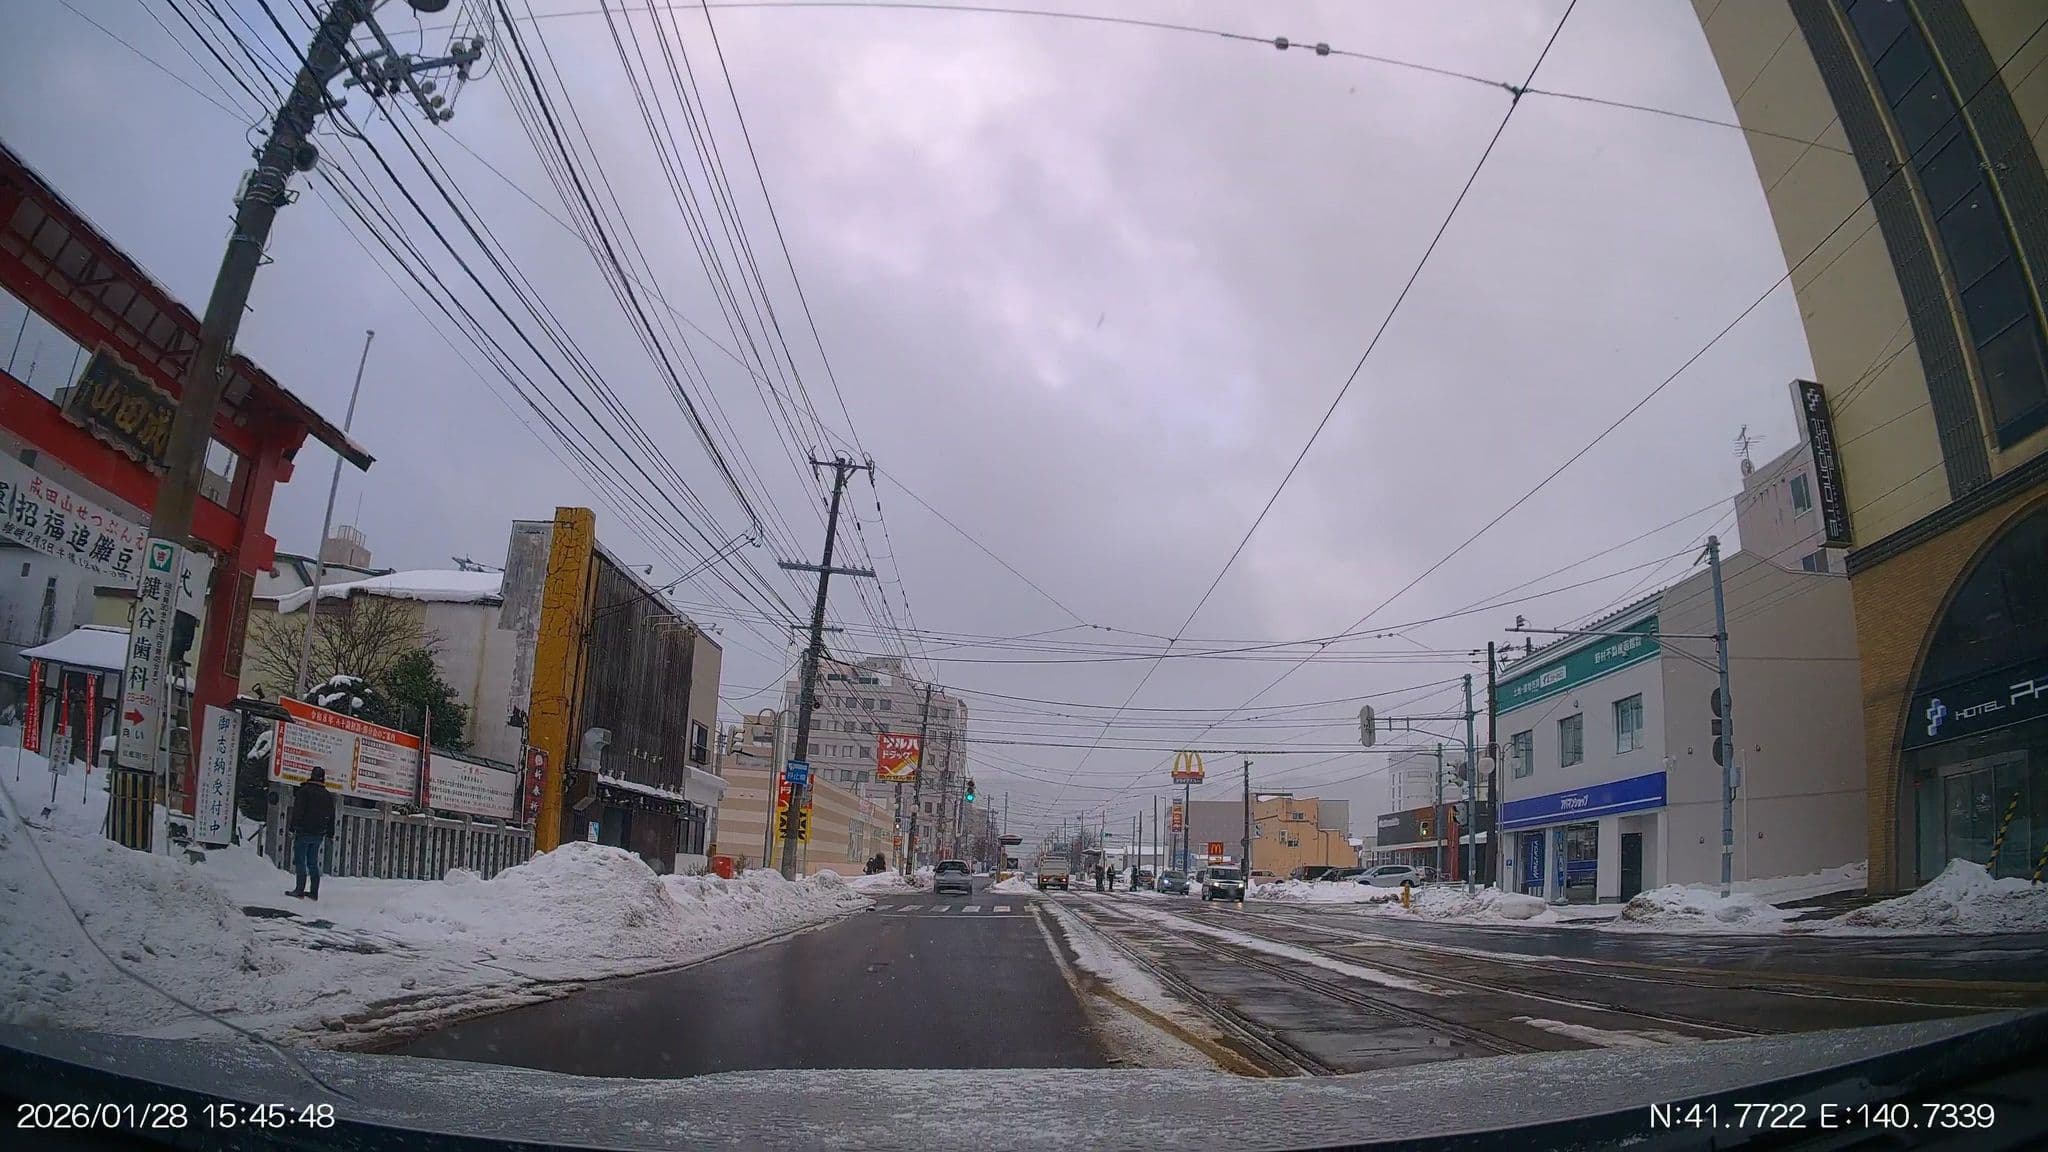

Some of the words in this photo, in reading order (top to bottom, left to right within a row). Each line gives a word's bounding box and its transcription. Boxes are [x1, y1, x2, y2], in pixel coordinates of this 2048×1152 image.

[128, 575, 162, 691] 鍵谷歯科
[1956, 700, 2006, 721] HOTEL
[882, 737, 919, 750] ツルハ
[882, 750, 912, 759] ドラッグ
